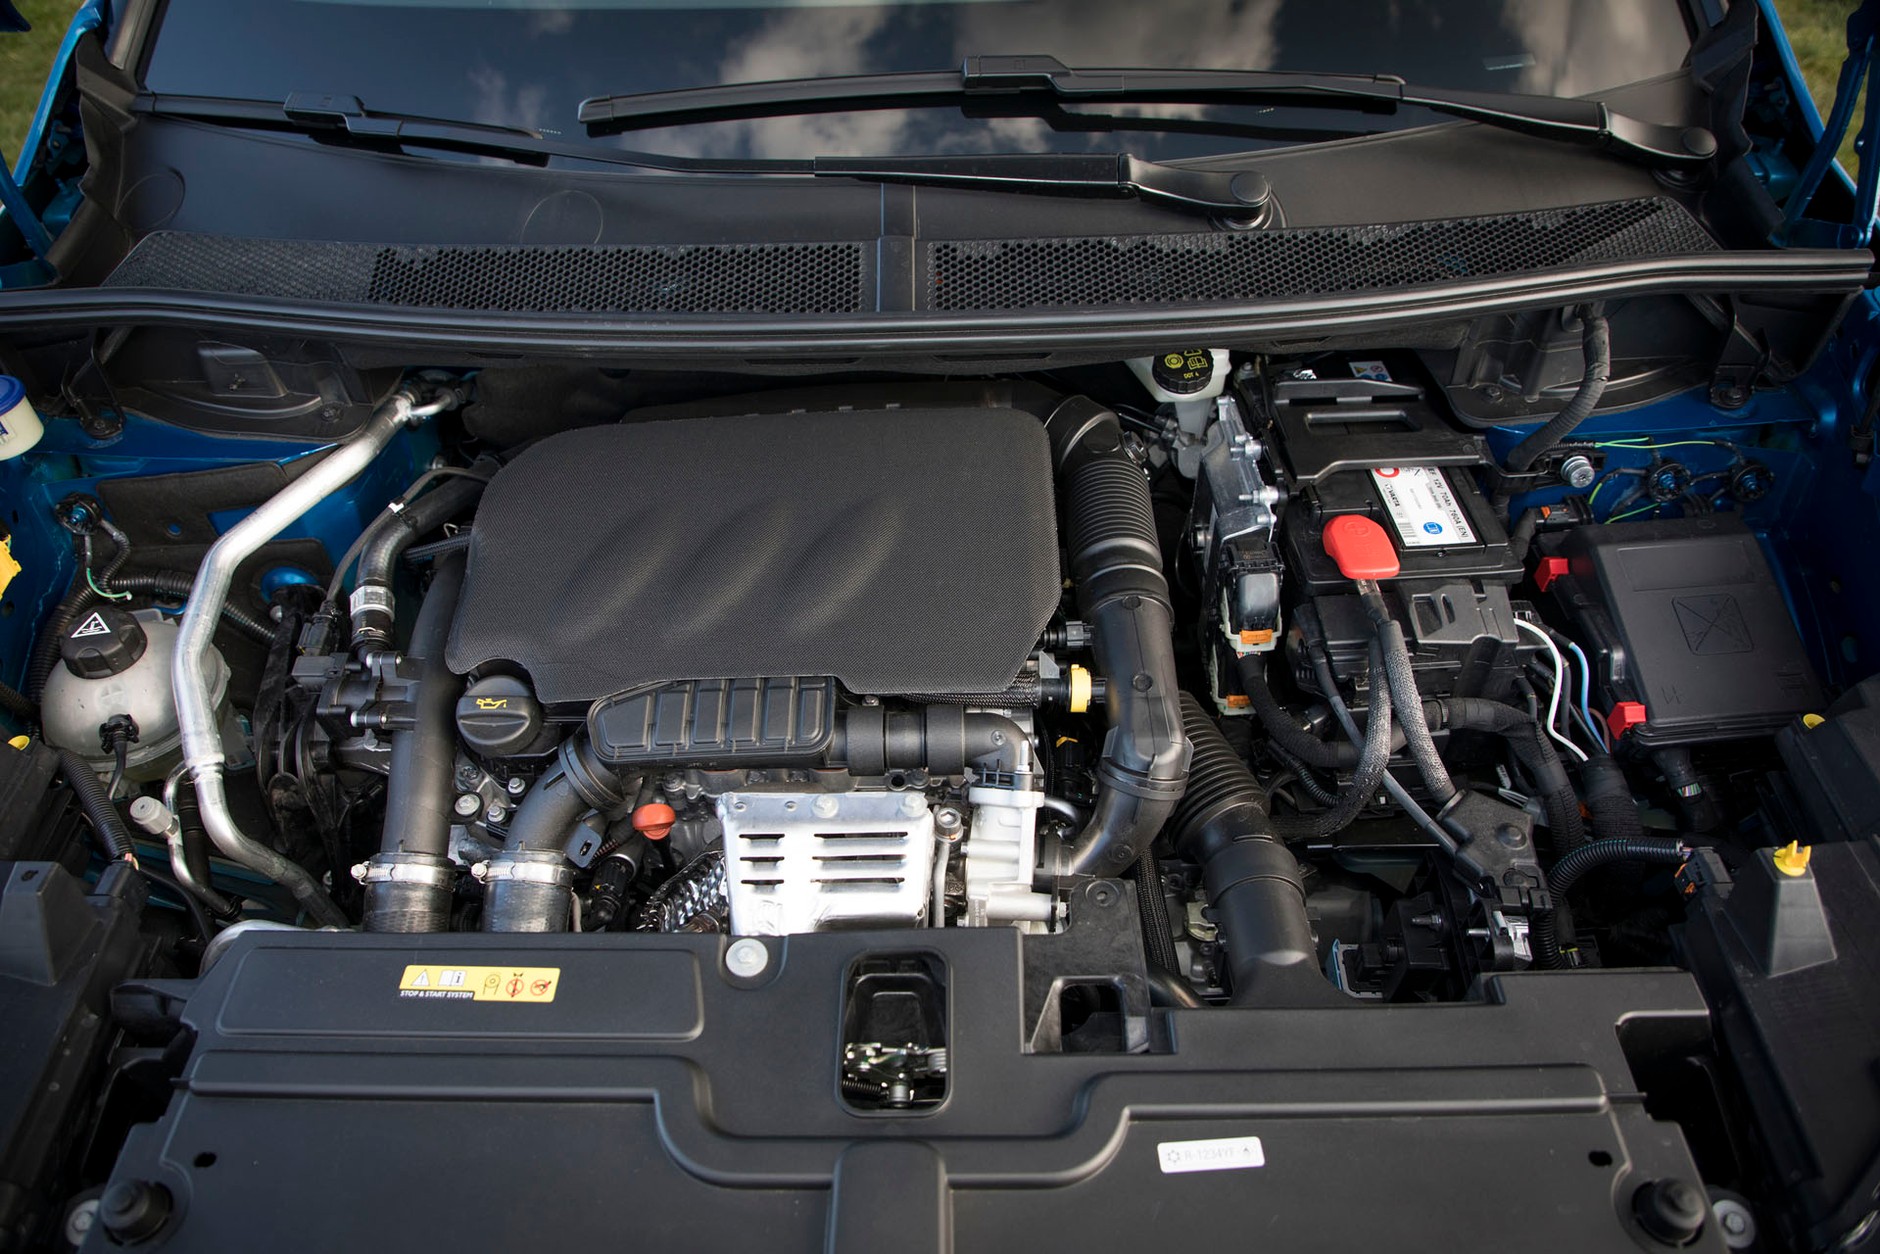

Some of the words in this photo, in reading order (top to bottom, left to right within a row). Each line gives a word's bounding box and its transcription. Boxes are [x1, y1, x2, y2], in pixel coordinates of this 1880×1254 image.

[1388, 489, 1400, 507] VARTA
[1434, 479, 1444, 488] 12V
[1440, 492, 1451, 506] 70Ah
[1449, 509, 1461, 524] 760A
[400, 990, 419, 998] STOP
[419, 990, 424, 998] &
